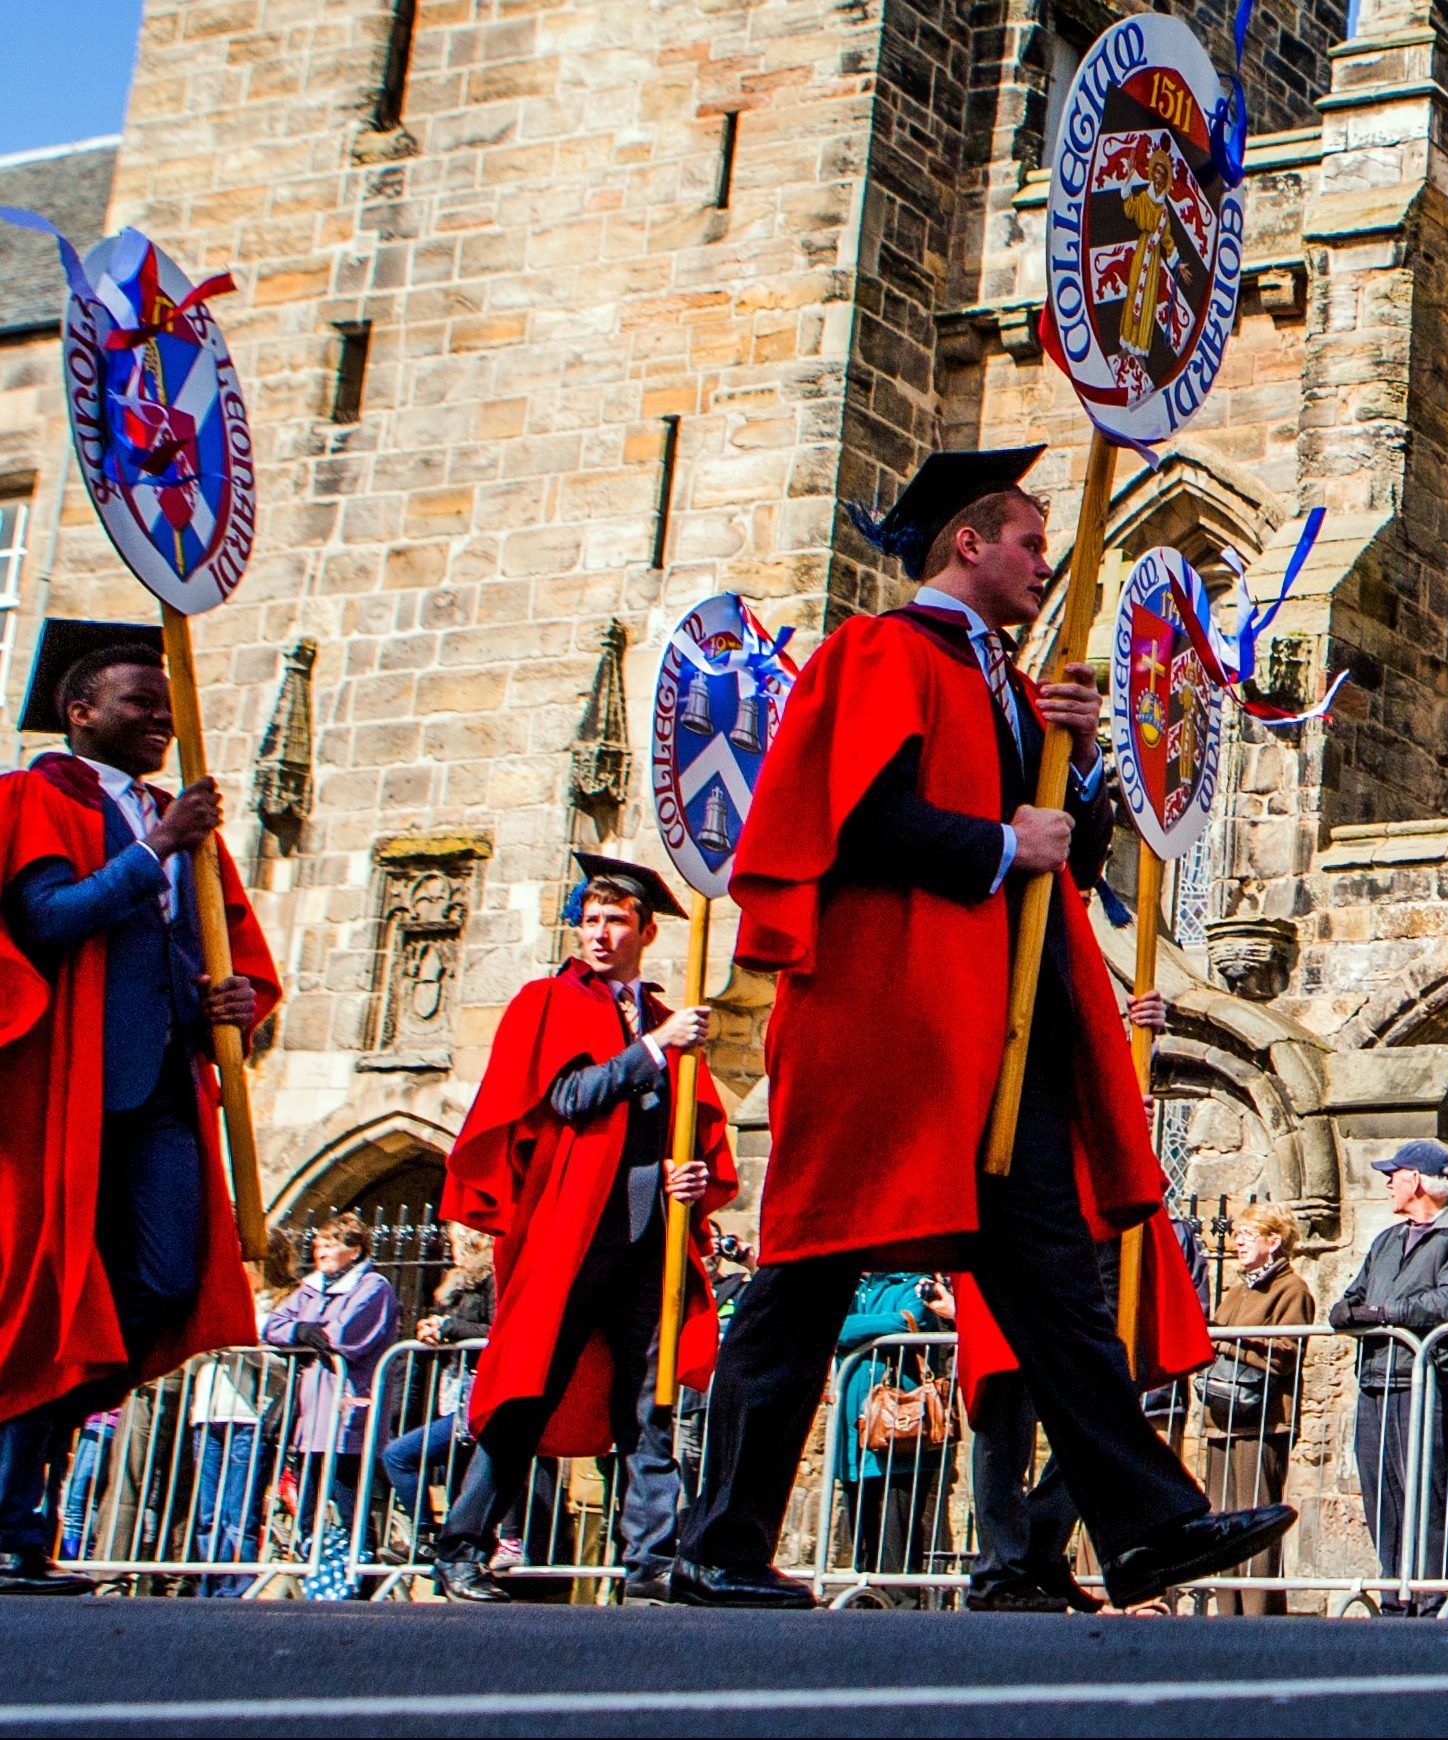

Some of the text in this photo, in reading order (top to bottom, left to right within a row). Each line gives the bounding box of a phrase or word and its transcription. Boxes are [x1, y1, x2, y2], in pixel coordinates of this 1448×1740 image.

[1052, 22, 1148, 363] COLLEGIUM
[1150, 72, 1192, 134] 1511
[1162, 190, 1244, 433] EONARDI
[208, 356, 256, 599] LEONARDI
[1114, 556, 1159, 814] COLLEGIUM
